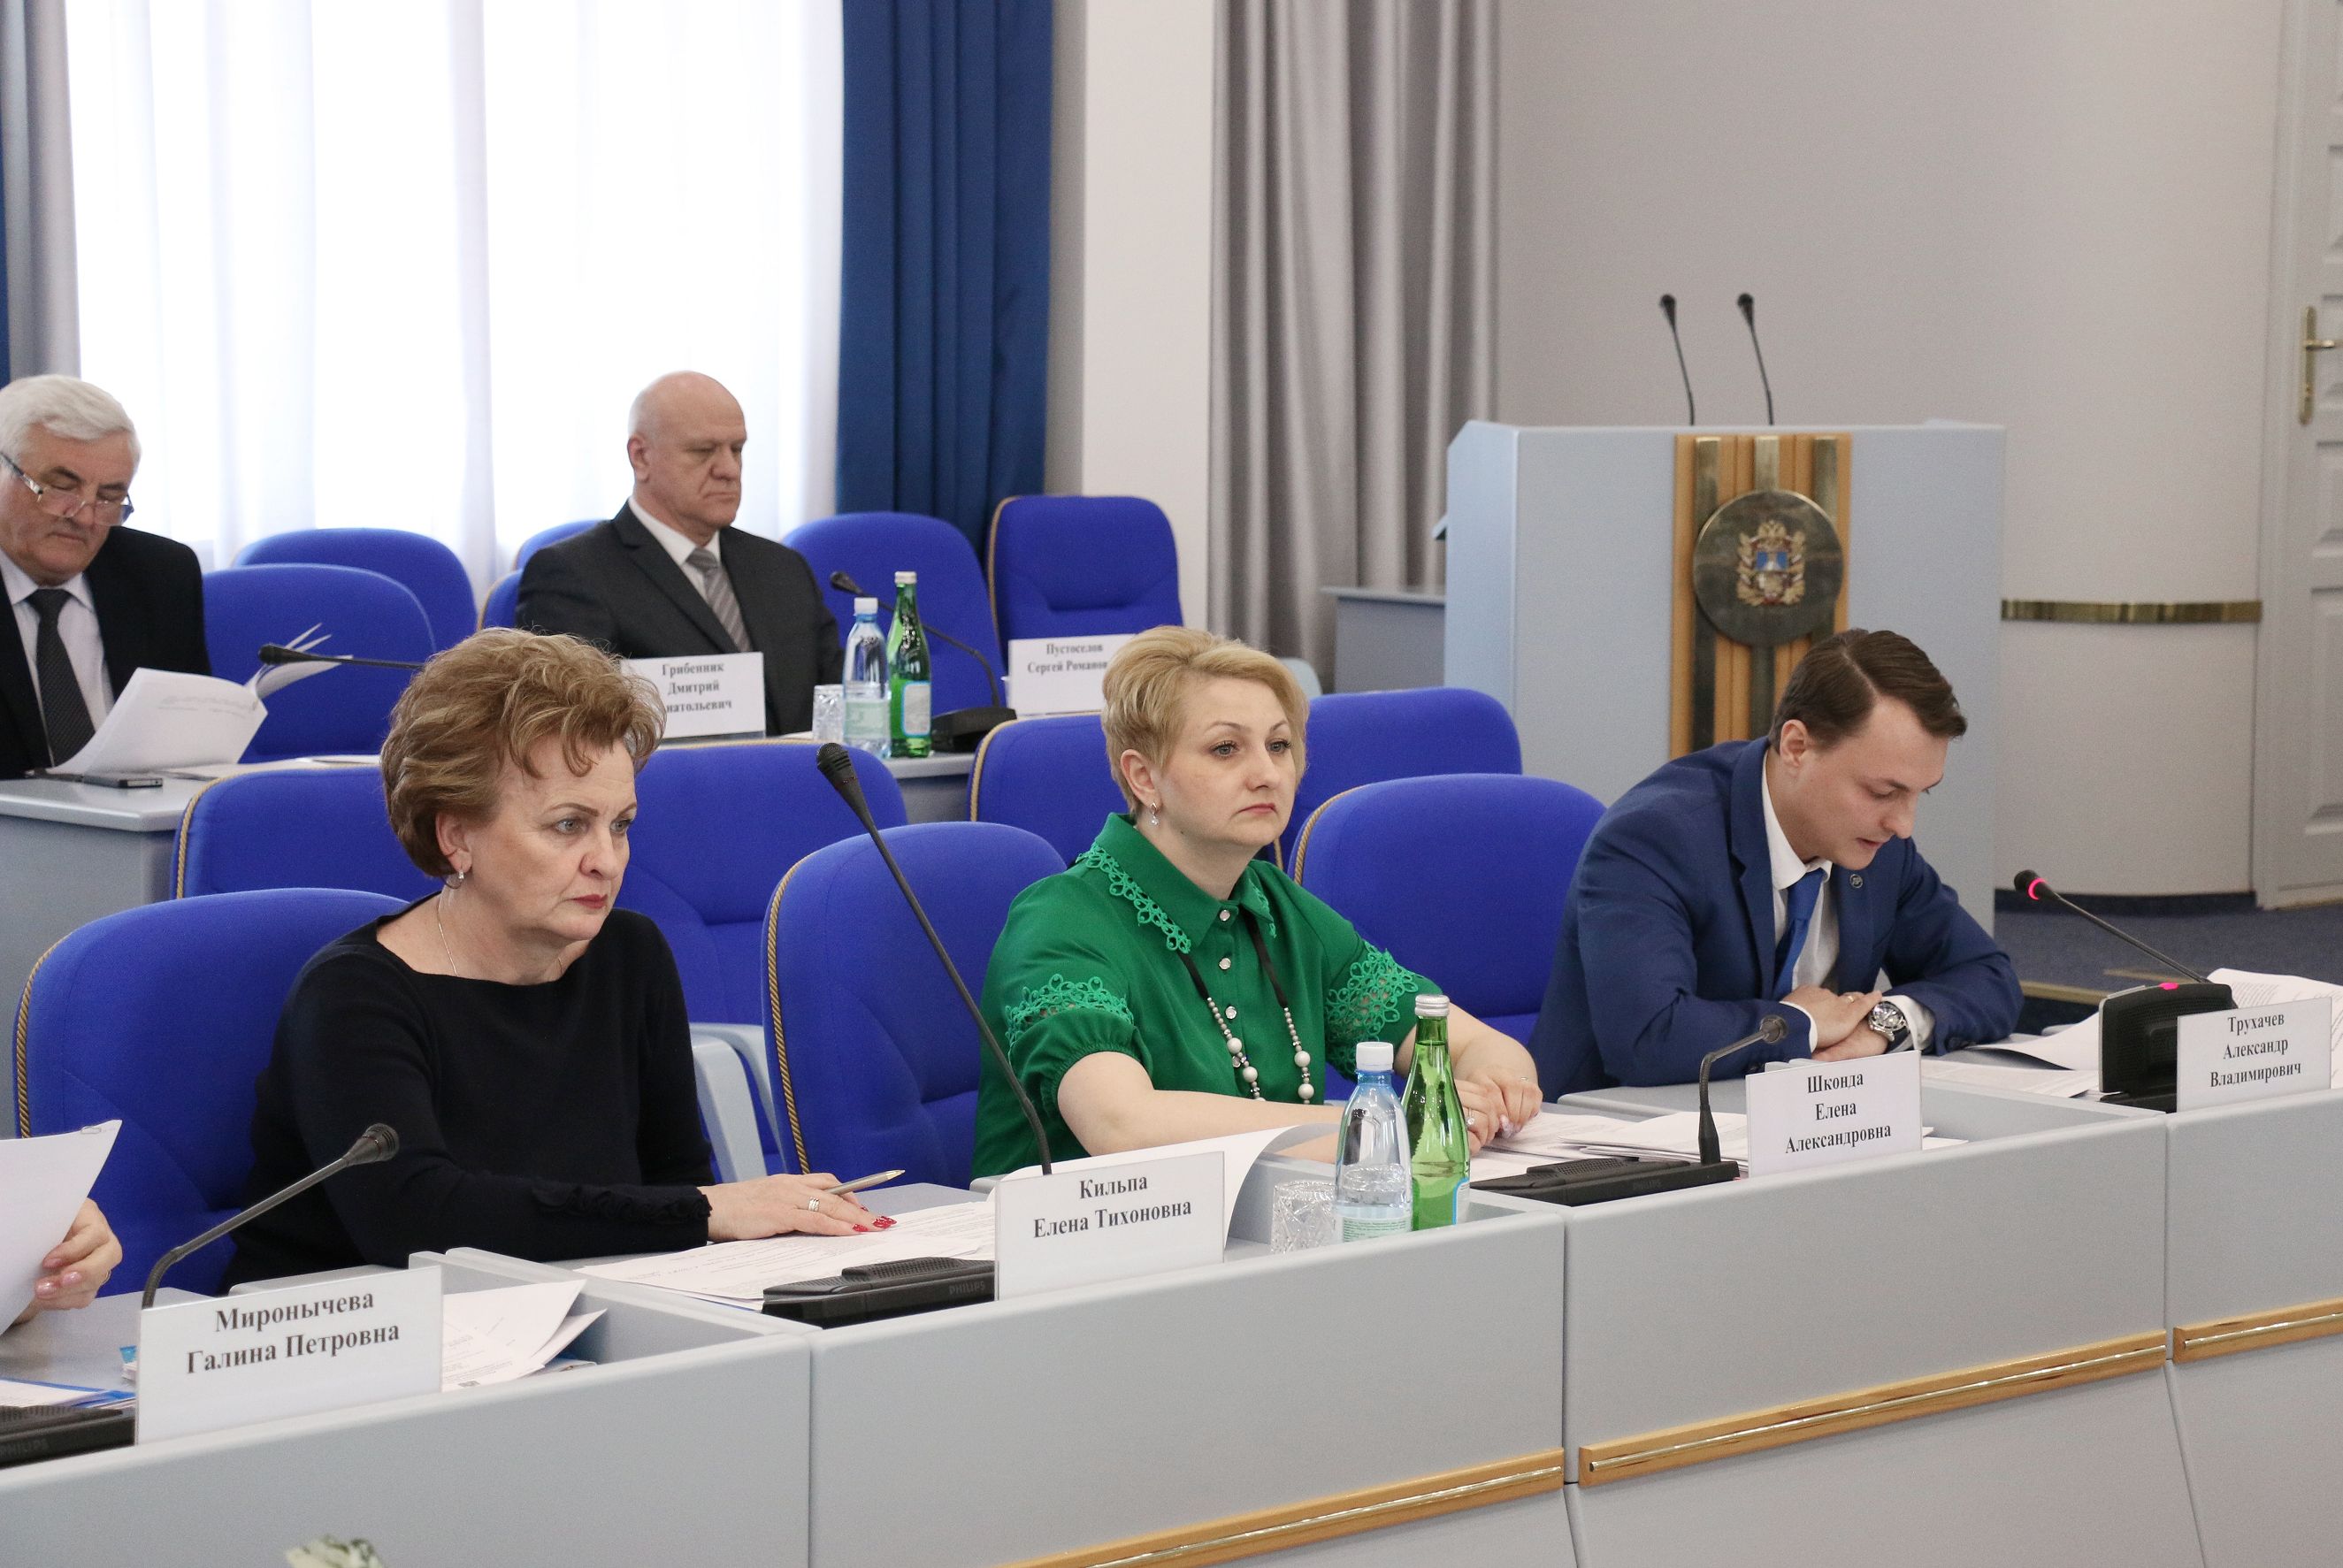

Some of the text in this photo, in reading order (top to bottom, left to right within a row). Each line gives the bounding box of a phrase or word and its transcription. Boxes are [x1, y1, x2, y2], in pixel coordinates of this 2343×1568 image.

[662, 662, 724, 678] Грибенник
[1027, 661, 1063, 676] Сергей
[667, 679, 720, 695] Дмитрий
[666, 700, 732, 713] натольевич
[2228, 1013, 2285, 1036] Трухачев
[2223, 1038, 2288, 1059] Александр
[1807, 1073, 1864, 1094] Шконда
[2210, 1062, 2301, 1088] Владимирович
[1815, 1102, 1857, 1121] Елена
[1785, 1125, 1891, 1154] Александровна
[1079, 1176, 1148, 1199] Кильпа
[1033, 1201, 1191, 1238] Елена Тихоновна
[948, 1281, 985, 1296] PHILIPS
[215, 1293, 373, 1333] Миронычева
[187, 1324, 400, 1374] Галина Петровна
